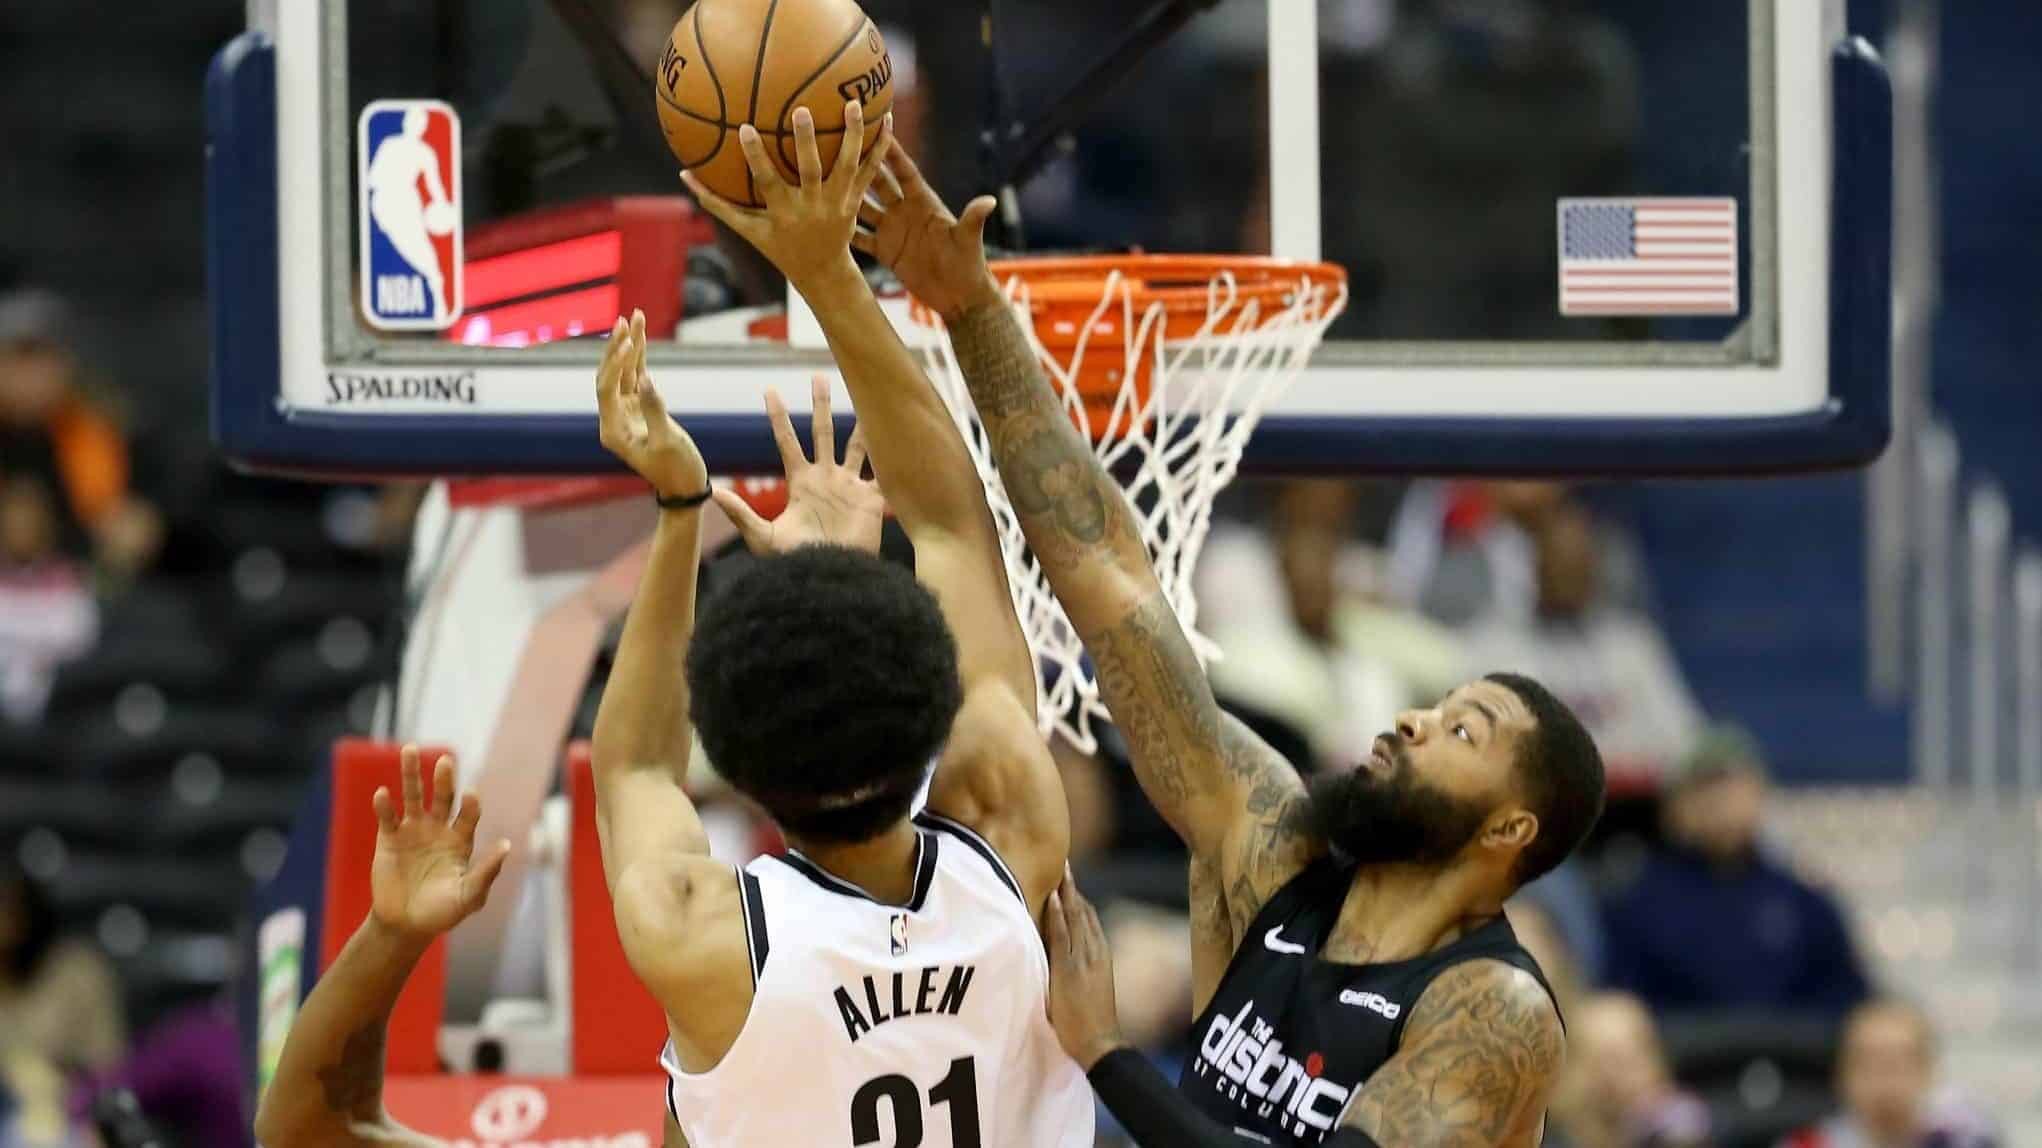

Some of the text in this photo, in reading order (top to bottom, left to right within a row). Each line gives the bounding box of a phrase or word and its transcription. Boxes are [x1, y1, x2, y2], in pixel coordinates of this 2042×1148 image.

[377, 274, 426, 314] NBA
[327, 371, 476, 404] SPALDING
[833, 964, 977, 1043] ALLEN
[1339, 989, 1401, 1020] GEICO
